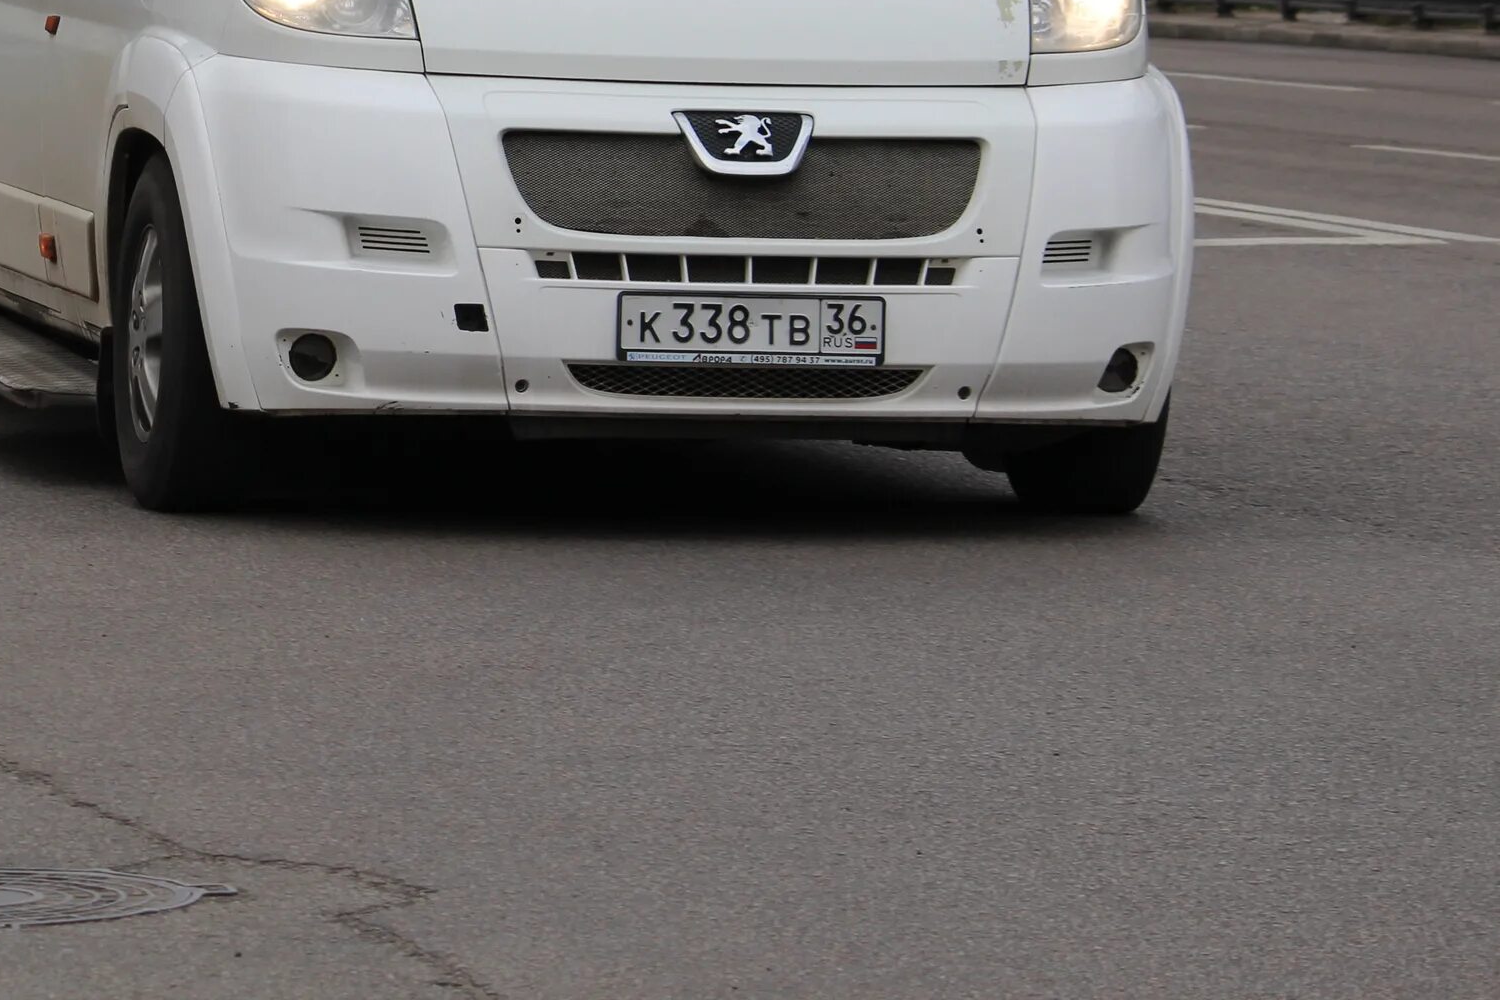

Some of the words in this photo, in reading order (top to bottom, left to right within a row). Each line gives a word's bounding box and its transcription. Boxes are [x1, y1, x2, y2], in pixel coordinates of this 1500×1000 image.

[826, 303, 867, 335] 36
[823, 336, 853, 348] RUS
[776, 355, 793, 363] 787
[795, 355, 807, 363] 94
[809, 356, 821, 364] 37
